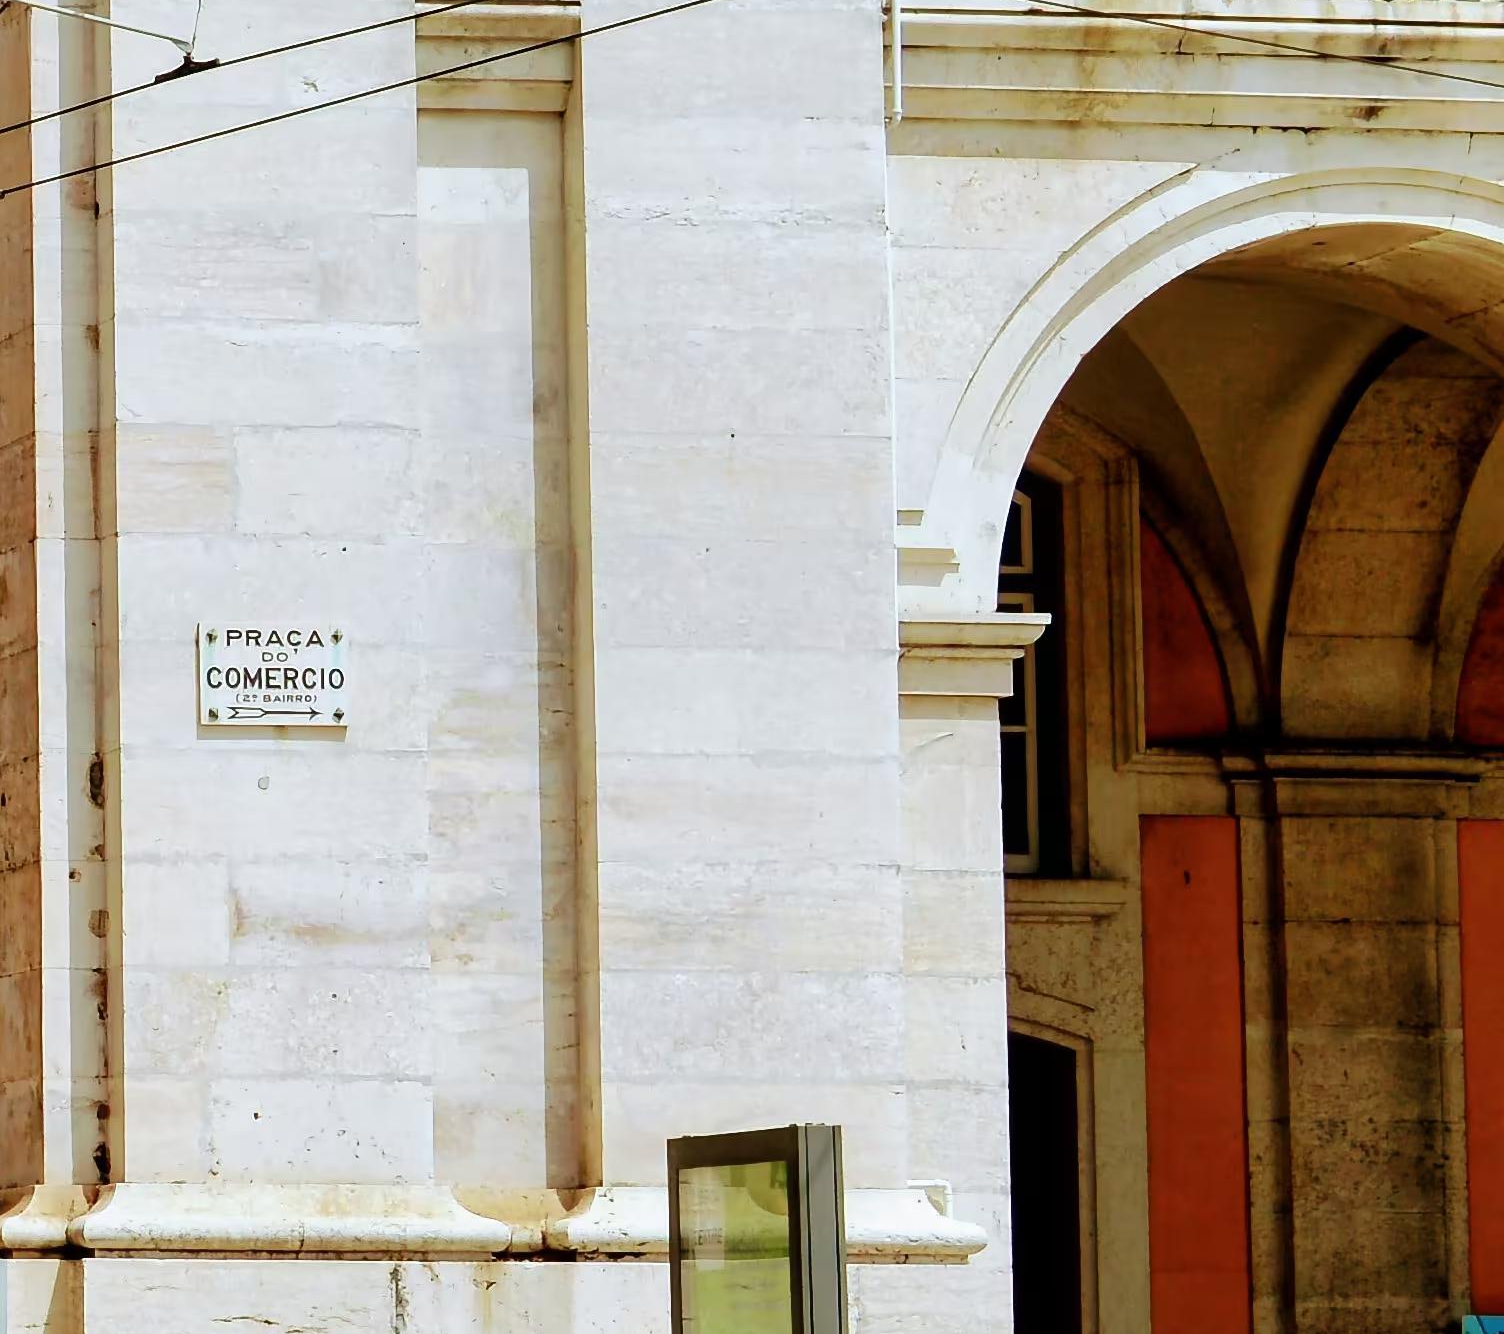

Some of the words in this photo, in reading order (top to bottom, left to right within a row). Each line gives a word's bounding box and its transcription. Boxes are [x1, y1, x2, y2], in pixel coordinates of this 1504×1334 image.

[226, 629, 325, 655] PRAÇA
[261, 651, 289, 663] DO
[206, 666, 345, 690] COMERCIO
[262, 693, 318, 704] BAIRRO)
